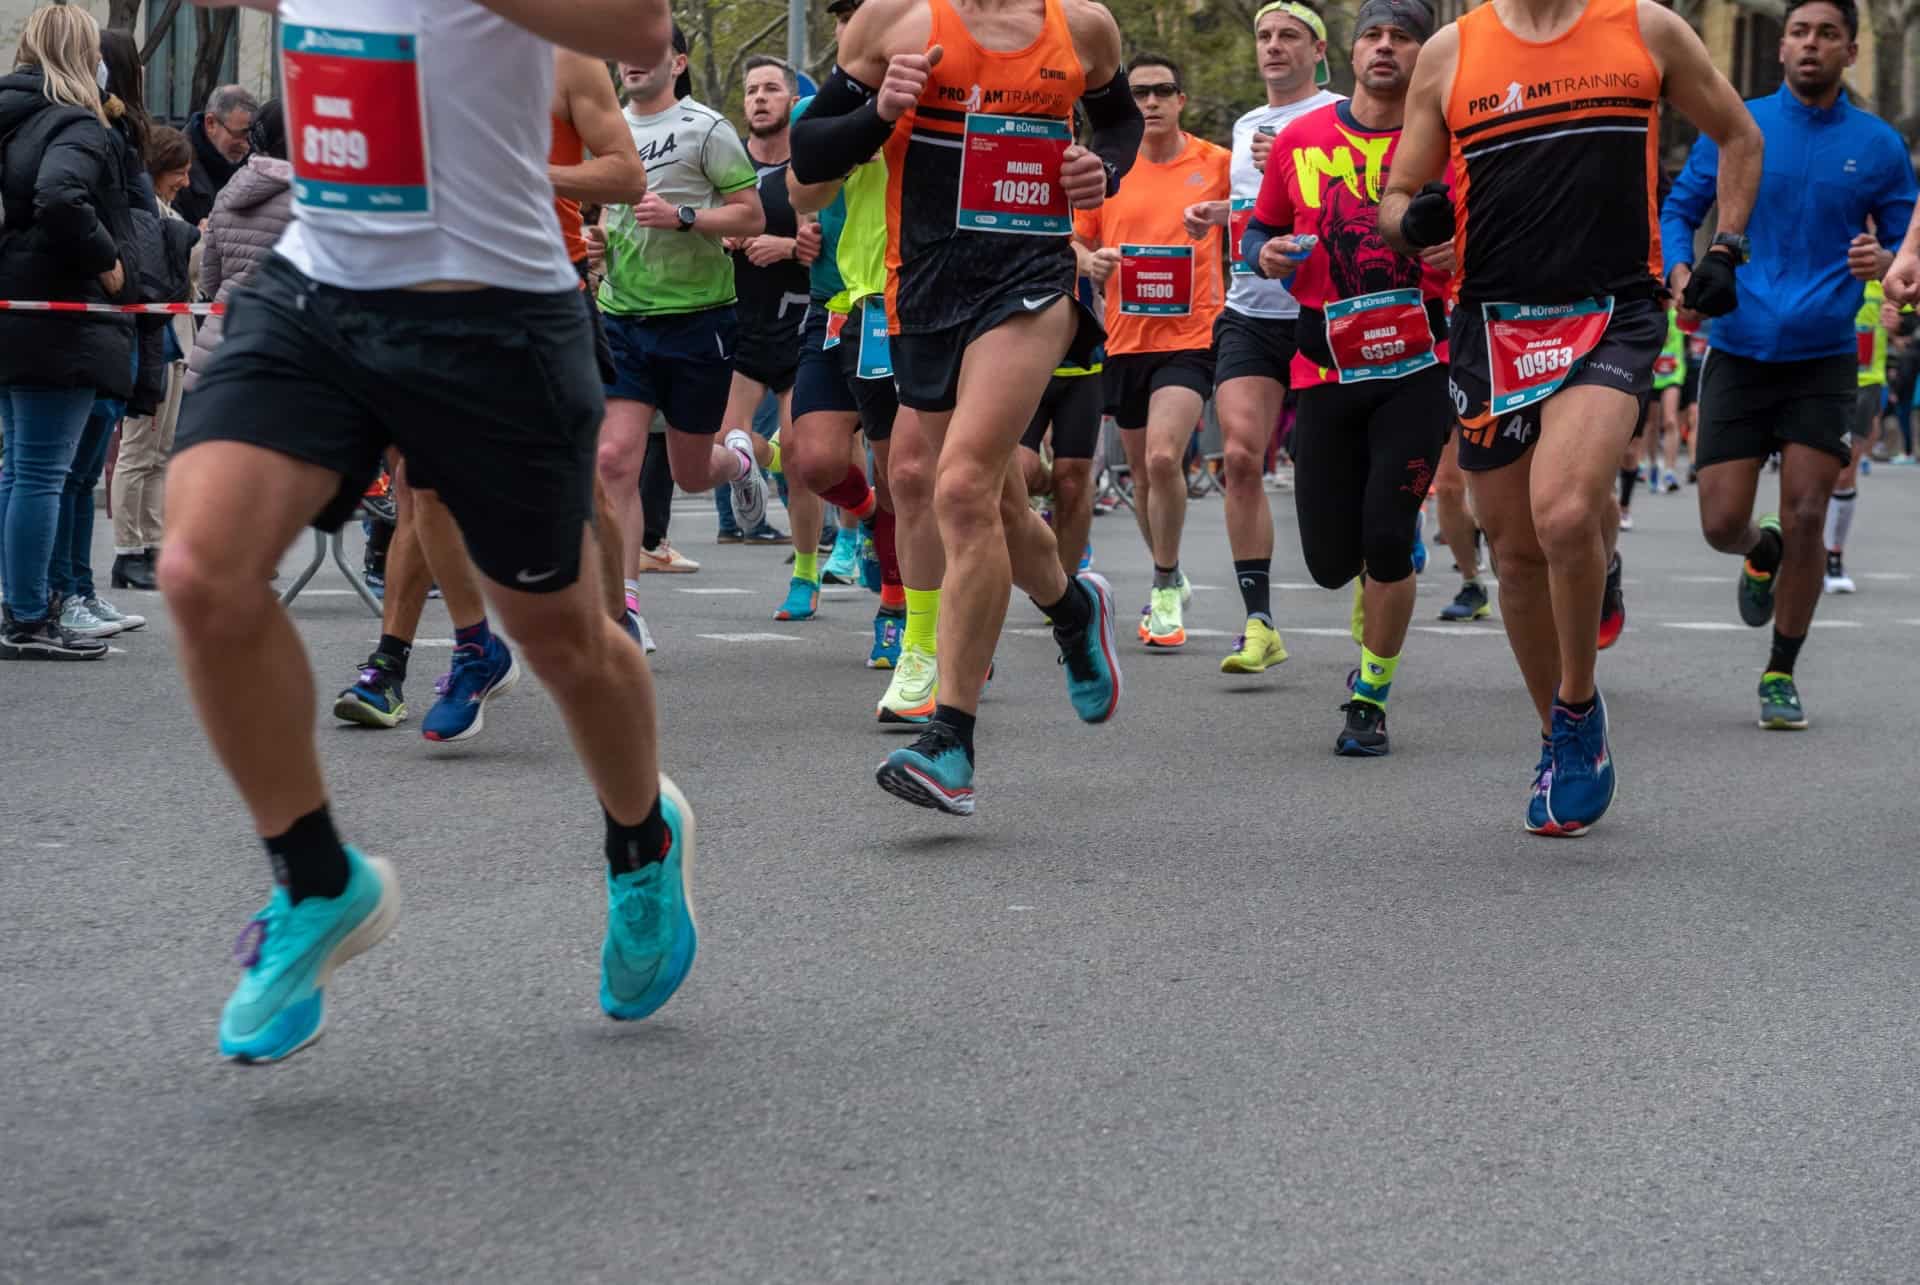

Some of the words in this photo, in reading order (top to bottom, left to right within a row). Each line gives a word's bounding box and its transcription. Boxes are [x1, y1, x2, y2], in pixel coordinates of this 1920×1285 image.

[938, 85, 966, 102] PRO
[1468, 93, 1500, 116] PRO
[303, 124, 369, 170] 8199
[1006, 160, 1043, 175] MANUEL
[992, 179, 1051, 206] 10928
[1136, 283, 1174, 298] 11500
[1530, 302, 1575, 317] eDreams
[1363, 326, 1397, 341] RONALD
[1513, 346, 1573, 380] 10933
[1448, 375, 1468, 415] RO
